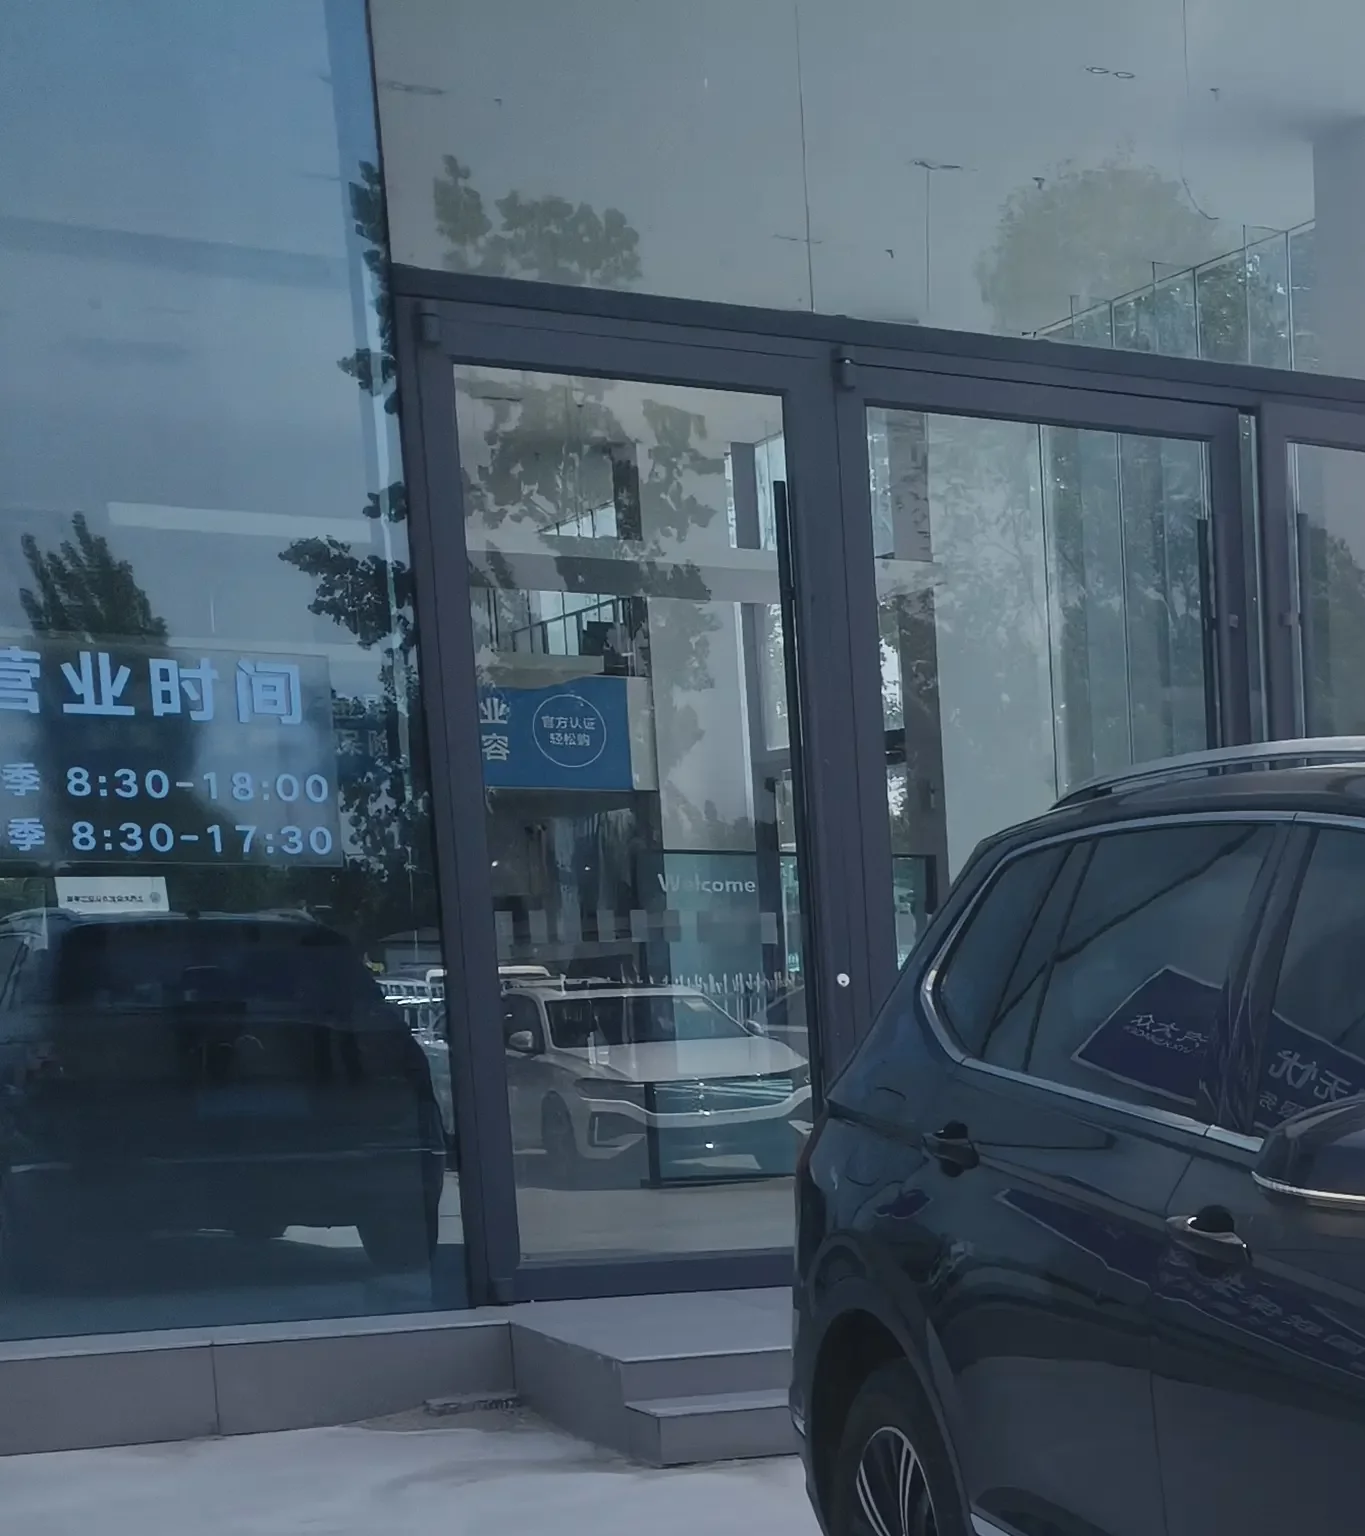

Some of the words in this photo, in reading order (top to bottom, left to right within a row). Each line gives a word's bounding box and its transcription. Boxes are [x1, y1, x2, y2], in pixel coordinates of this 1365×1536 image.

[0, 645, 303, 726] 营业时间
[541, 714, 597, 732] 官方认证
[1, 762, 41, 797] 季
[66, 766, 330, 804] 8:30-18:00
[7, 816, 46, 852] 季
[71, 821, 333, 855] 8:30-17:30
